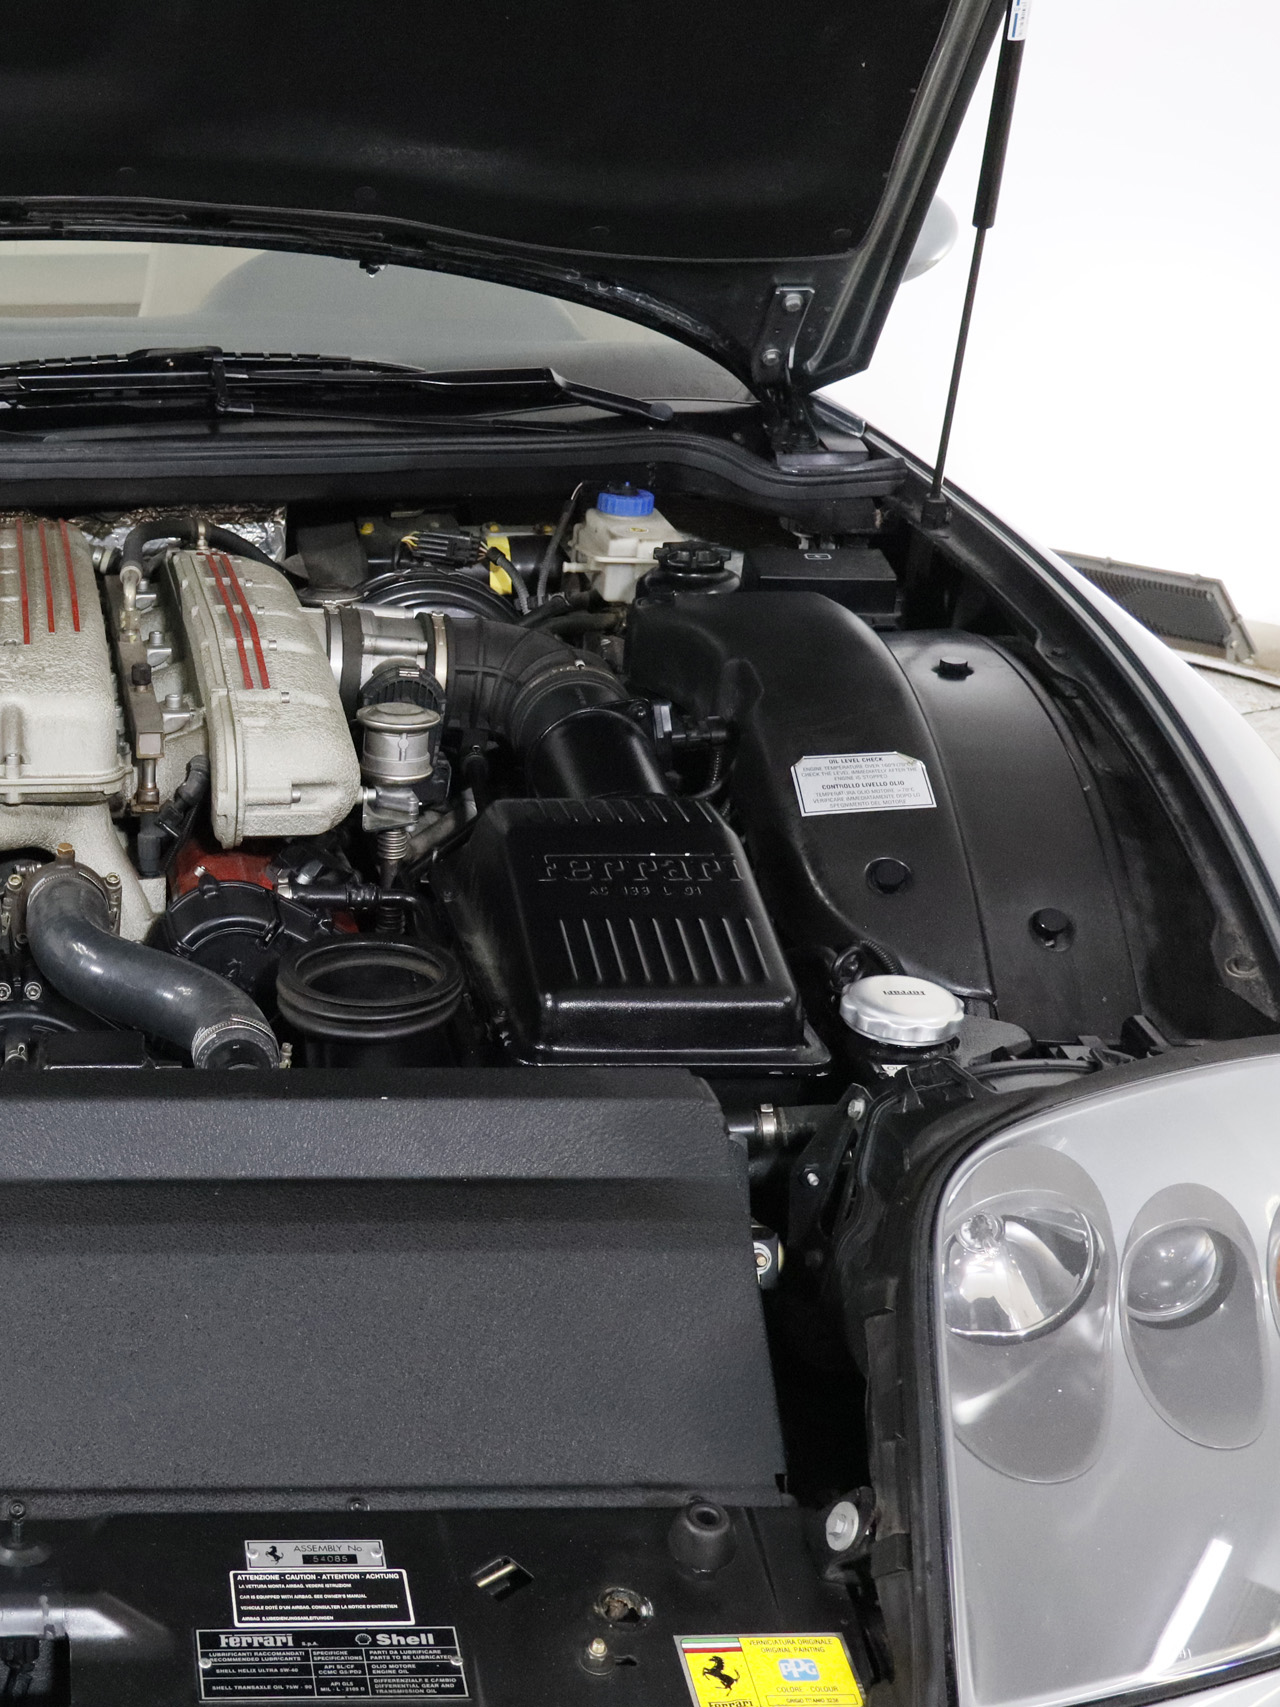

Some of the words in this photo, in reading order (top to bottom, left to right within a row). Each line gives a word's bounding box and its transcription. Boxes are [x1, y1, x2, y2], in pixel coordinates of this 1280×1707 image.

[313, 1555, 348, 1563] 54085
[219, 1633, 294, 1648] Ferrari
[376, 1633, 434, 1645] Shell
[780, 1658, 818, 1678] PPG
